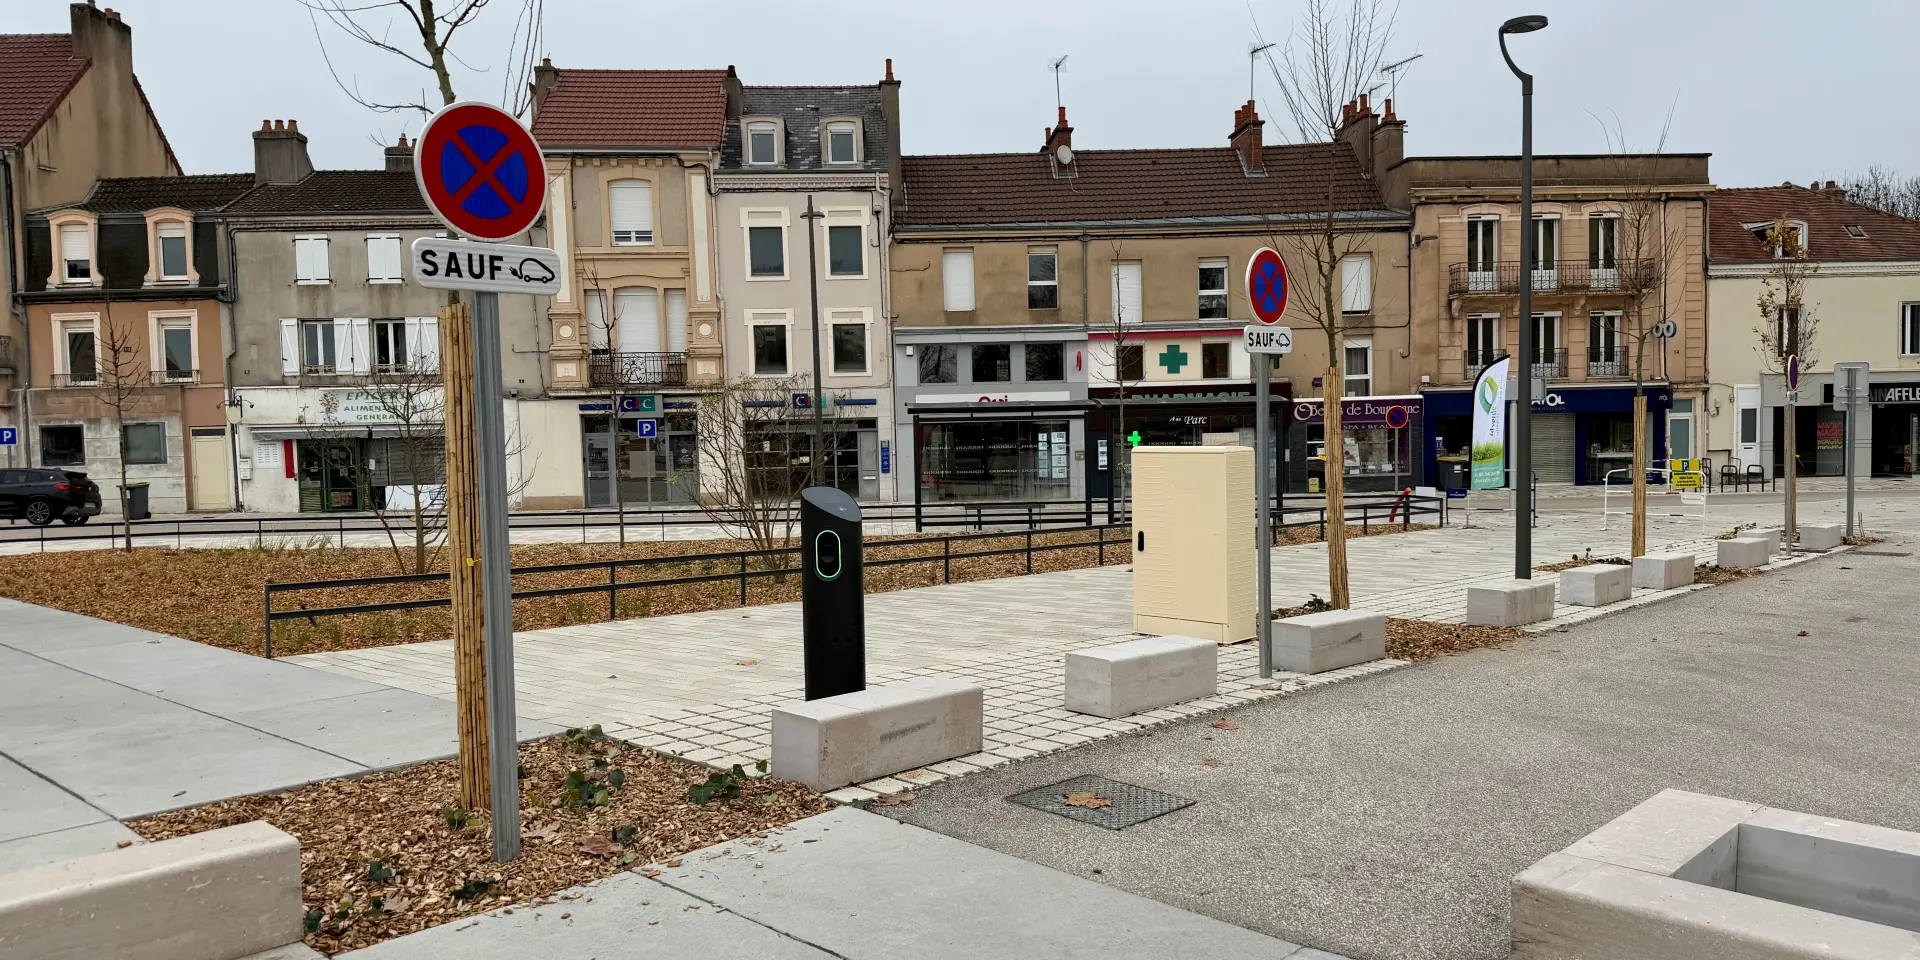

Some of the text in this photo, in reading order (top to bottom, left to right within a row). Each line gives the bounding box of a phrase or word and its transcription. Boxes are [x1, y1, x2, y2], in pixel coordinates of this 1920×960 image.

[421, 249, 504, 281] SAUF
[1248, 331, 1275, 348] SAUF
[623, 399, 652, 410] CIC
[1346, 403, 1361, 416] de
[1184, 416, 1208, 425] Parc
[643, 423, 652, 435] P
[3, 430, 12, 442] P
